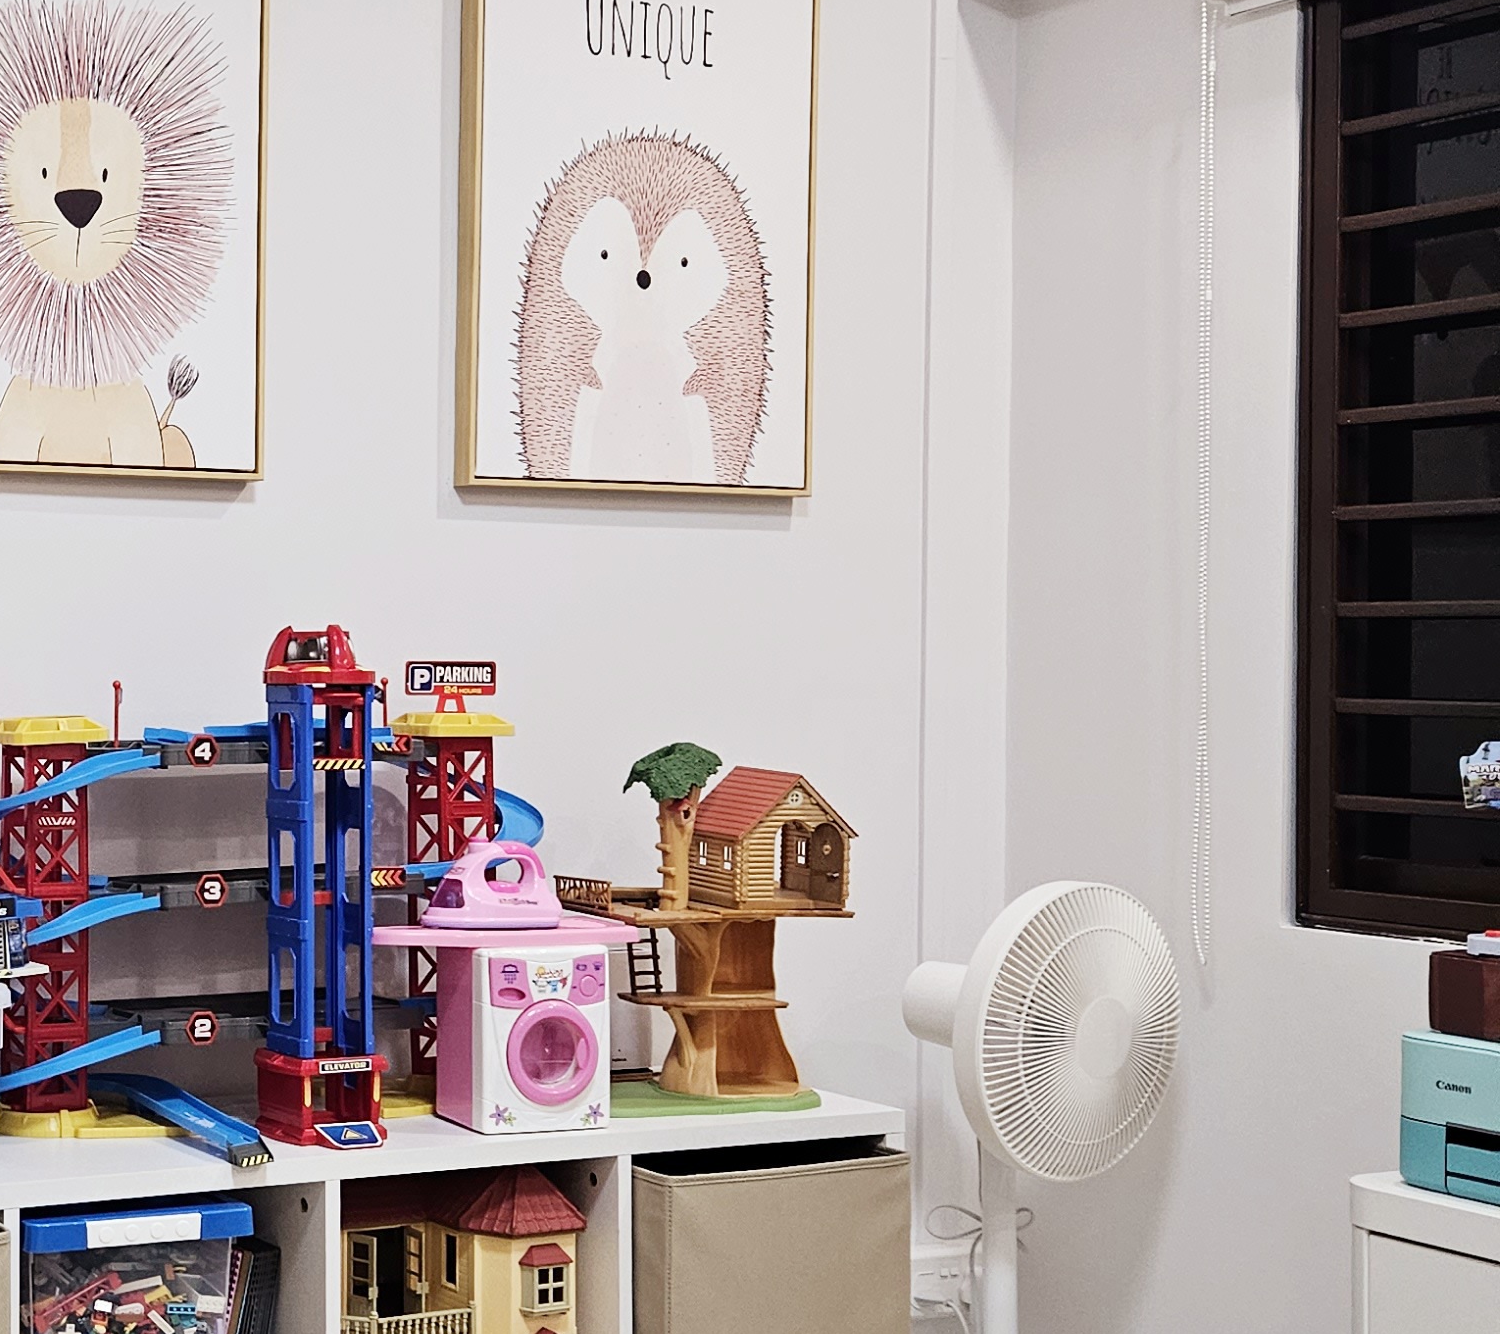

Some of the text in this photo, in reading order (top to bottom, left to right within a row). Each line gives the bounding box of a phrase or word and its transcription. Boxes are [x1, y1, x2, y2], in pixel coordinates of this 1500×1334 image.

[413, 668, 431, 689] P
[435, 666, 491, 682] PARKING
[443, 685, 457, 694] 24
[194, 741, 212, 761] 4
[203, 881, 221, 900] 3
[194, 1018, 211, 1038] 2
[324, 1061, 367, 1070] ELEVATOR
[1435, 1079, 1472, 1094] Canon
